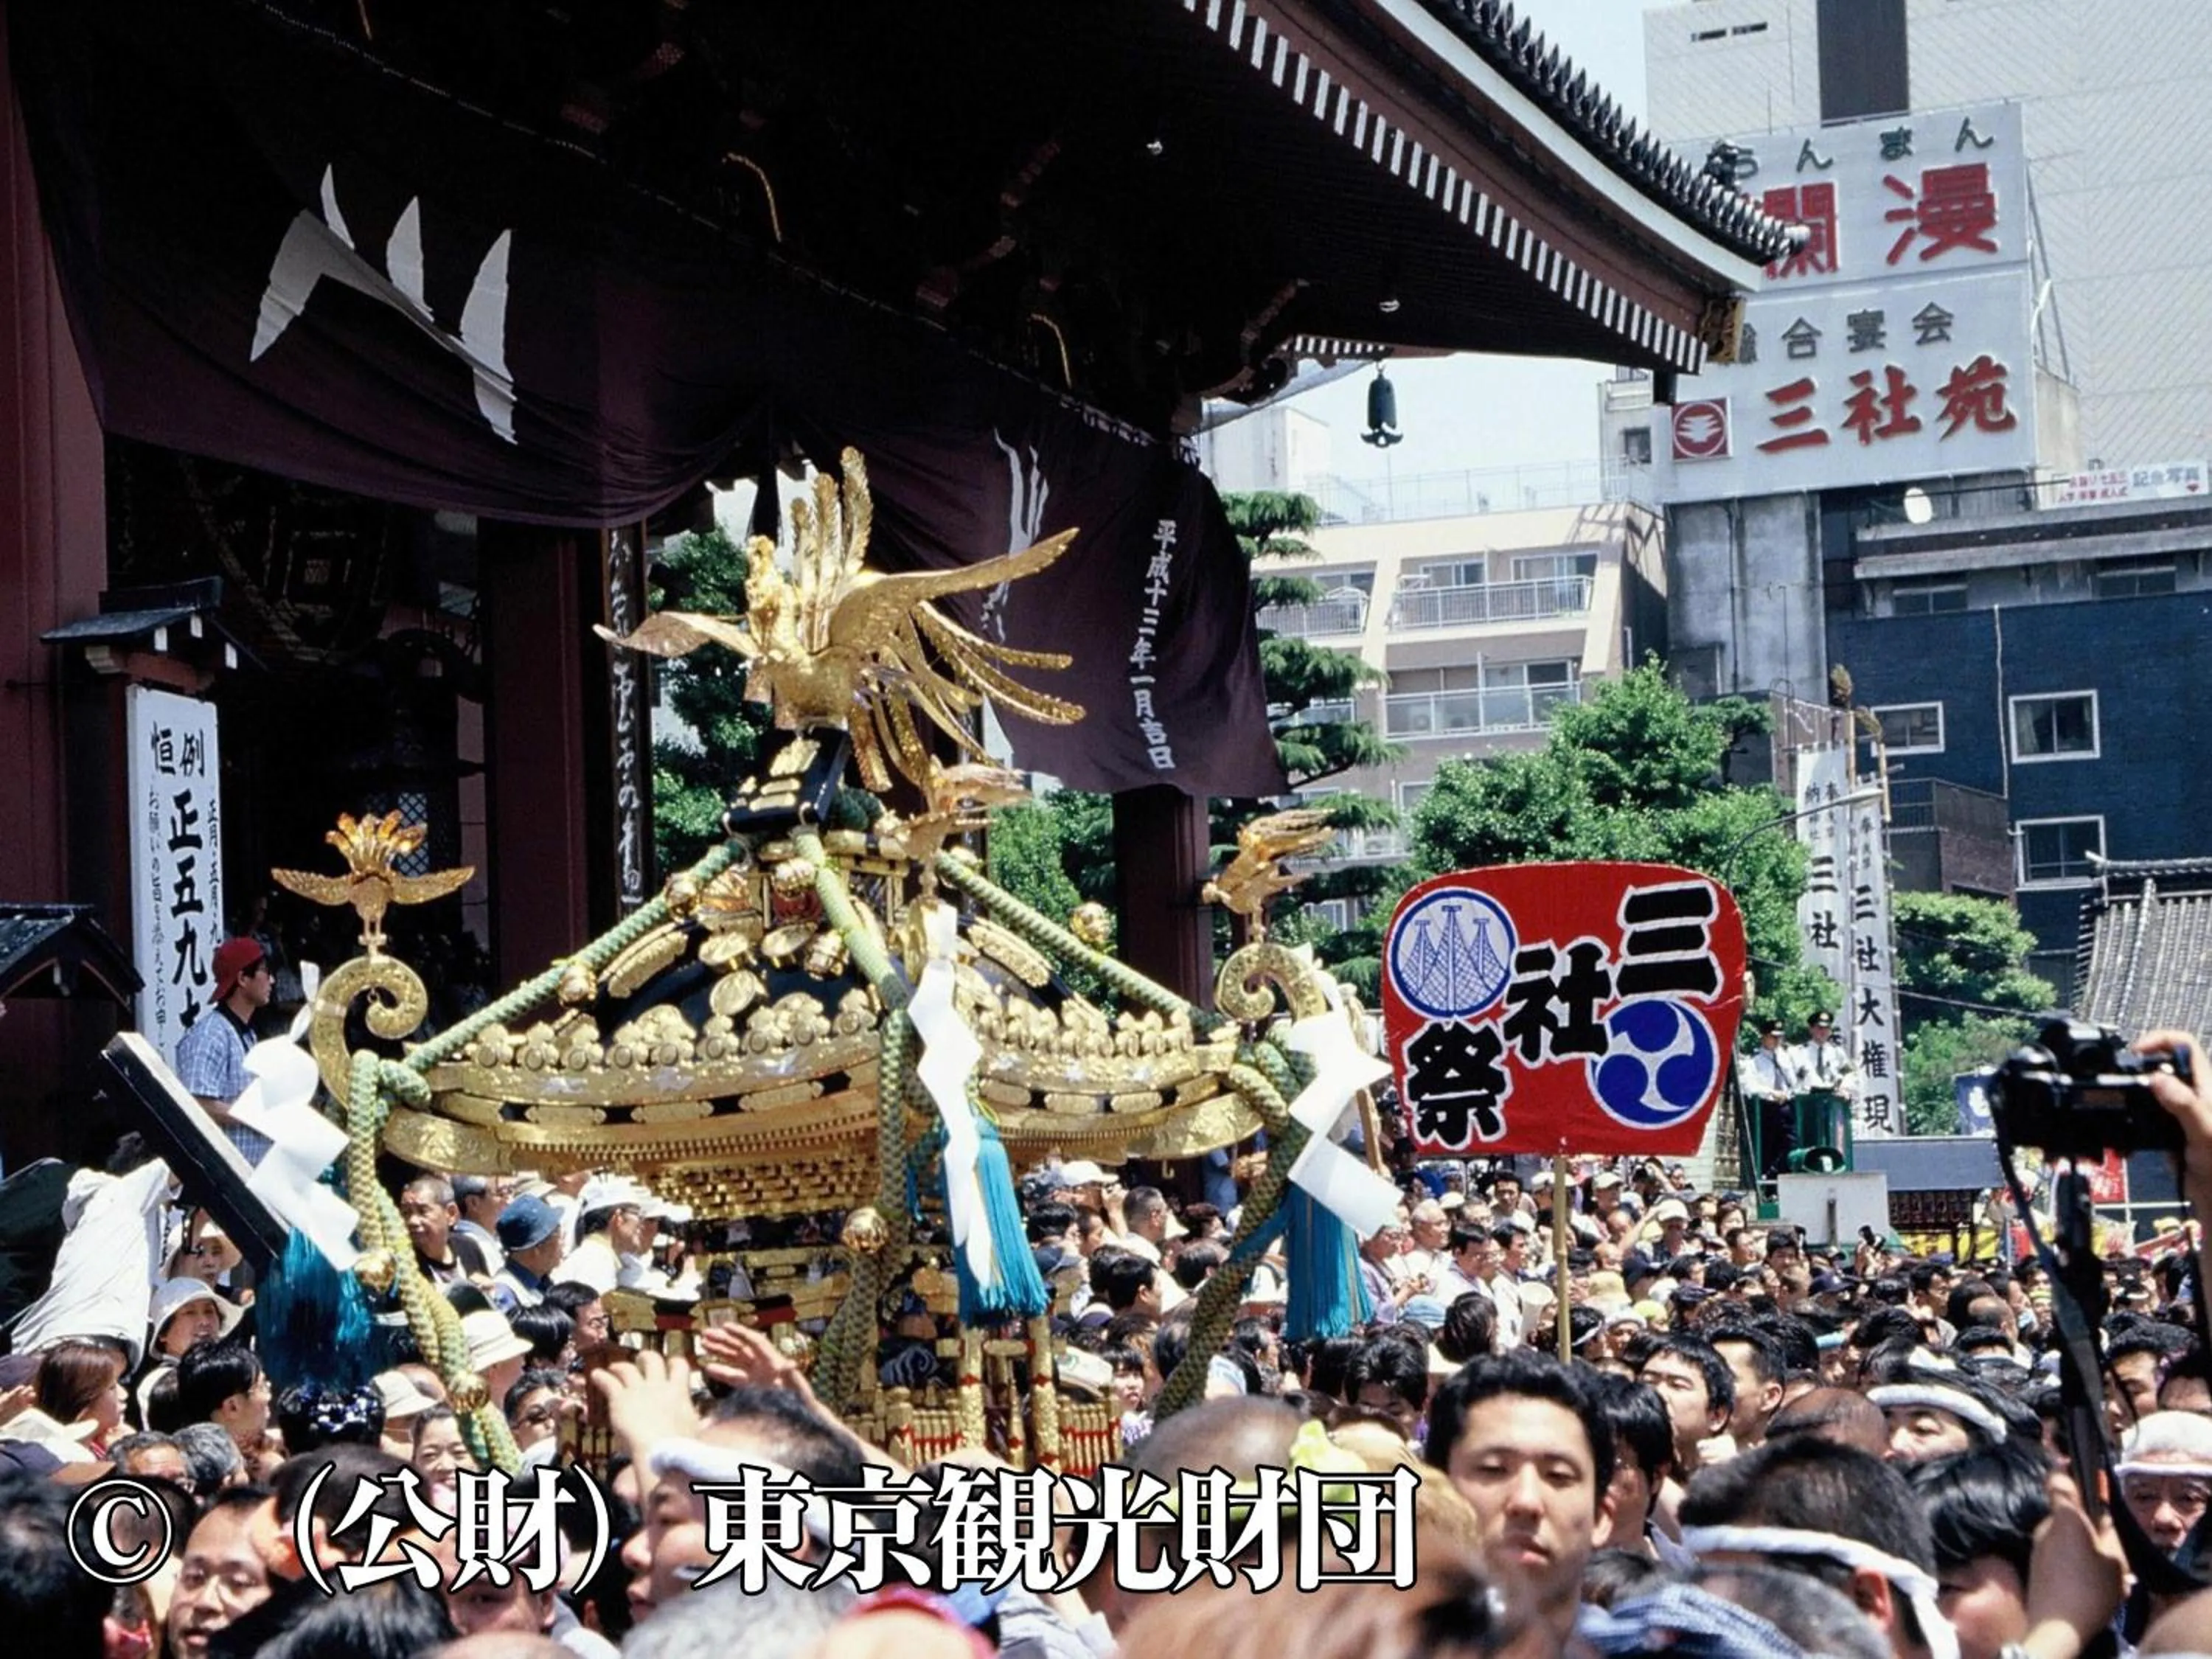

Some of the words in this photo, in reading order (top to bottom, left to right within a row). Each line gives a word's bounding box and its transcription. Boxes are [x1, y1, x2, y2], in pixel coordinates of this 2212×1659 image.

[1756, 355, 2017, 453] 三社苑
[150, 721, 205, 777] 恒例
[1129, 519, 1177, 769] 平成十三年一月吉日
[1405, 882, 1722, 1148] 三社祭
[1855, 885, 1893, 1132] 三社大権現
